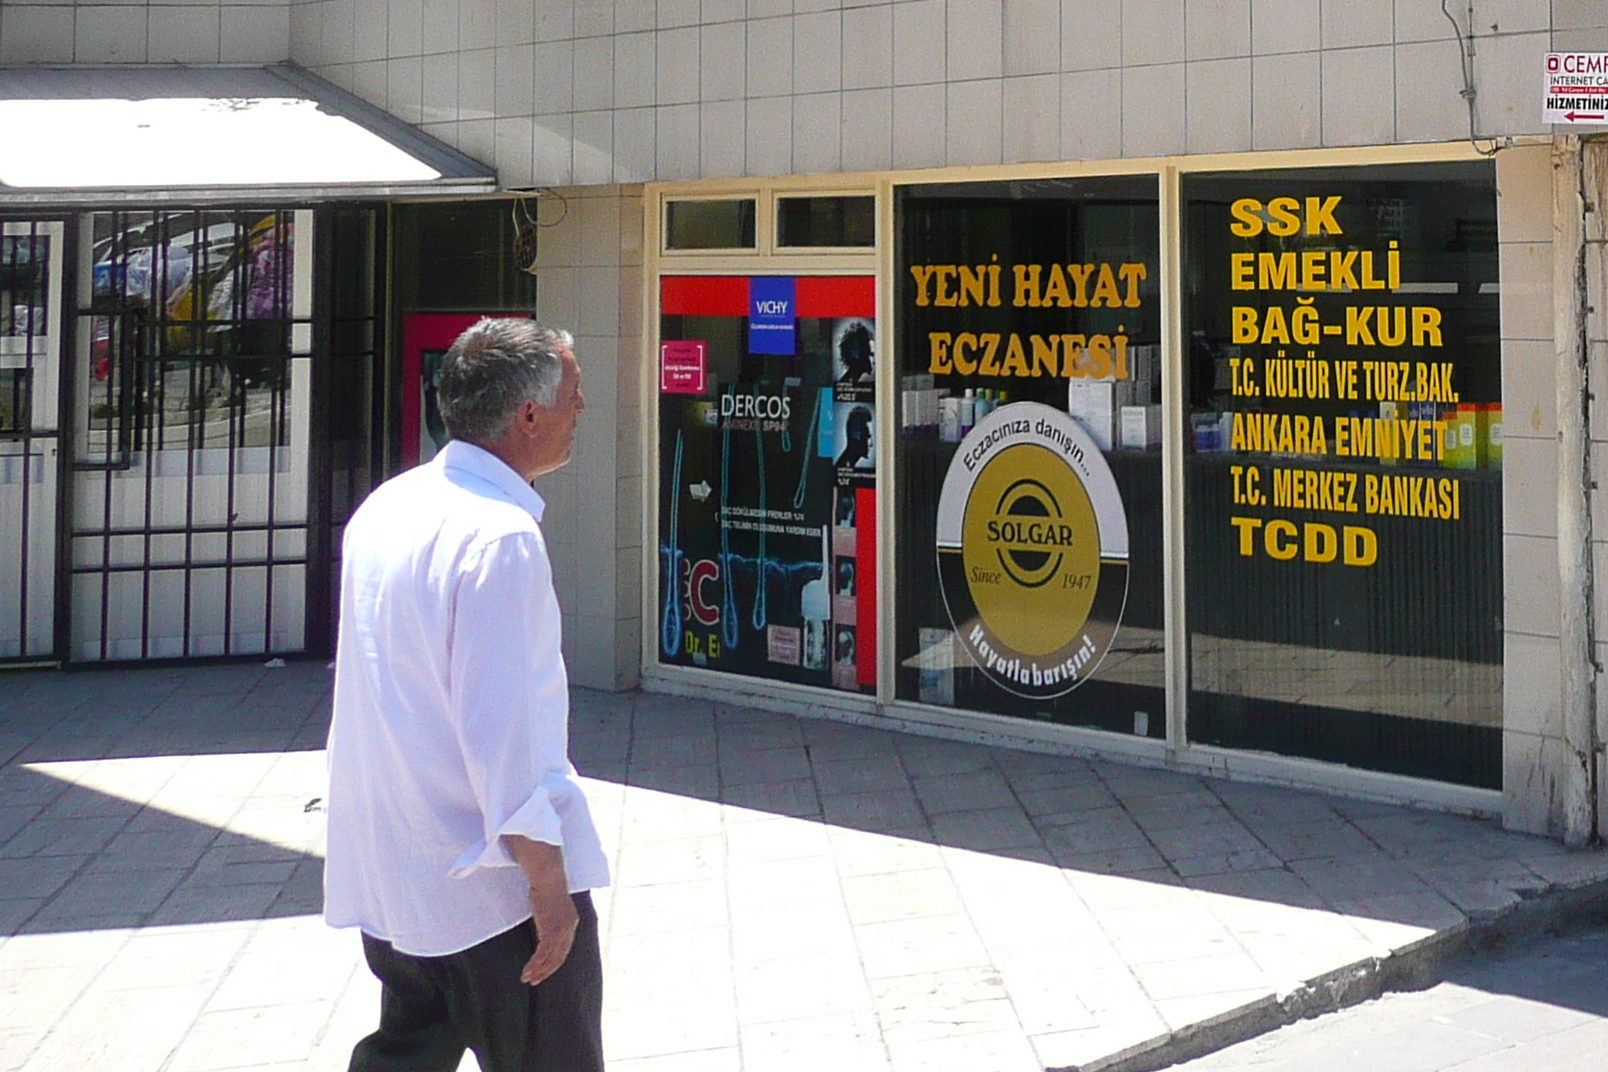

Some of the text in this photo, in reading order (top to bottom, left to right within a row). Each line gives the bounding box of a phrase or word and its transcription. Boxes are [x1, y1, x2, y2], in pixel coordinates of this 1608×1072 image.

[1550, 76, 1593, 85] INTERNET
[1231, 196, 1343, 238] SSK
[910, 253, 1147, 308] YENİ HAYAT
[1231, 240, 1401, 291] EMEKLİ
[756, 301, 788, 314] VICHY
[1231, 297, 1444, 348] BAĞ-KUR
[928, 325, 1130, 380] ECZANESİ
[1230, 358, 1259, 398] T.C.
[1265, 351, 1330, 400] KÜLTÜR
[1335, 361, 1358, 401] VE
[721, 394, 791, 419] DERCOS
[963, 418, 1031, 472] Eczacınıza
[1230, 409, 1447, 461] ANKARA EMNİYET
[1231, 466, 1460, 520] T.C. MERKEZ BANKASI
[987, 520, 1073, 546] SOLGAR
[1231, 517, 1379, 568] TCDD
[971, 566, 1092, 589] Since 1947
